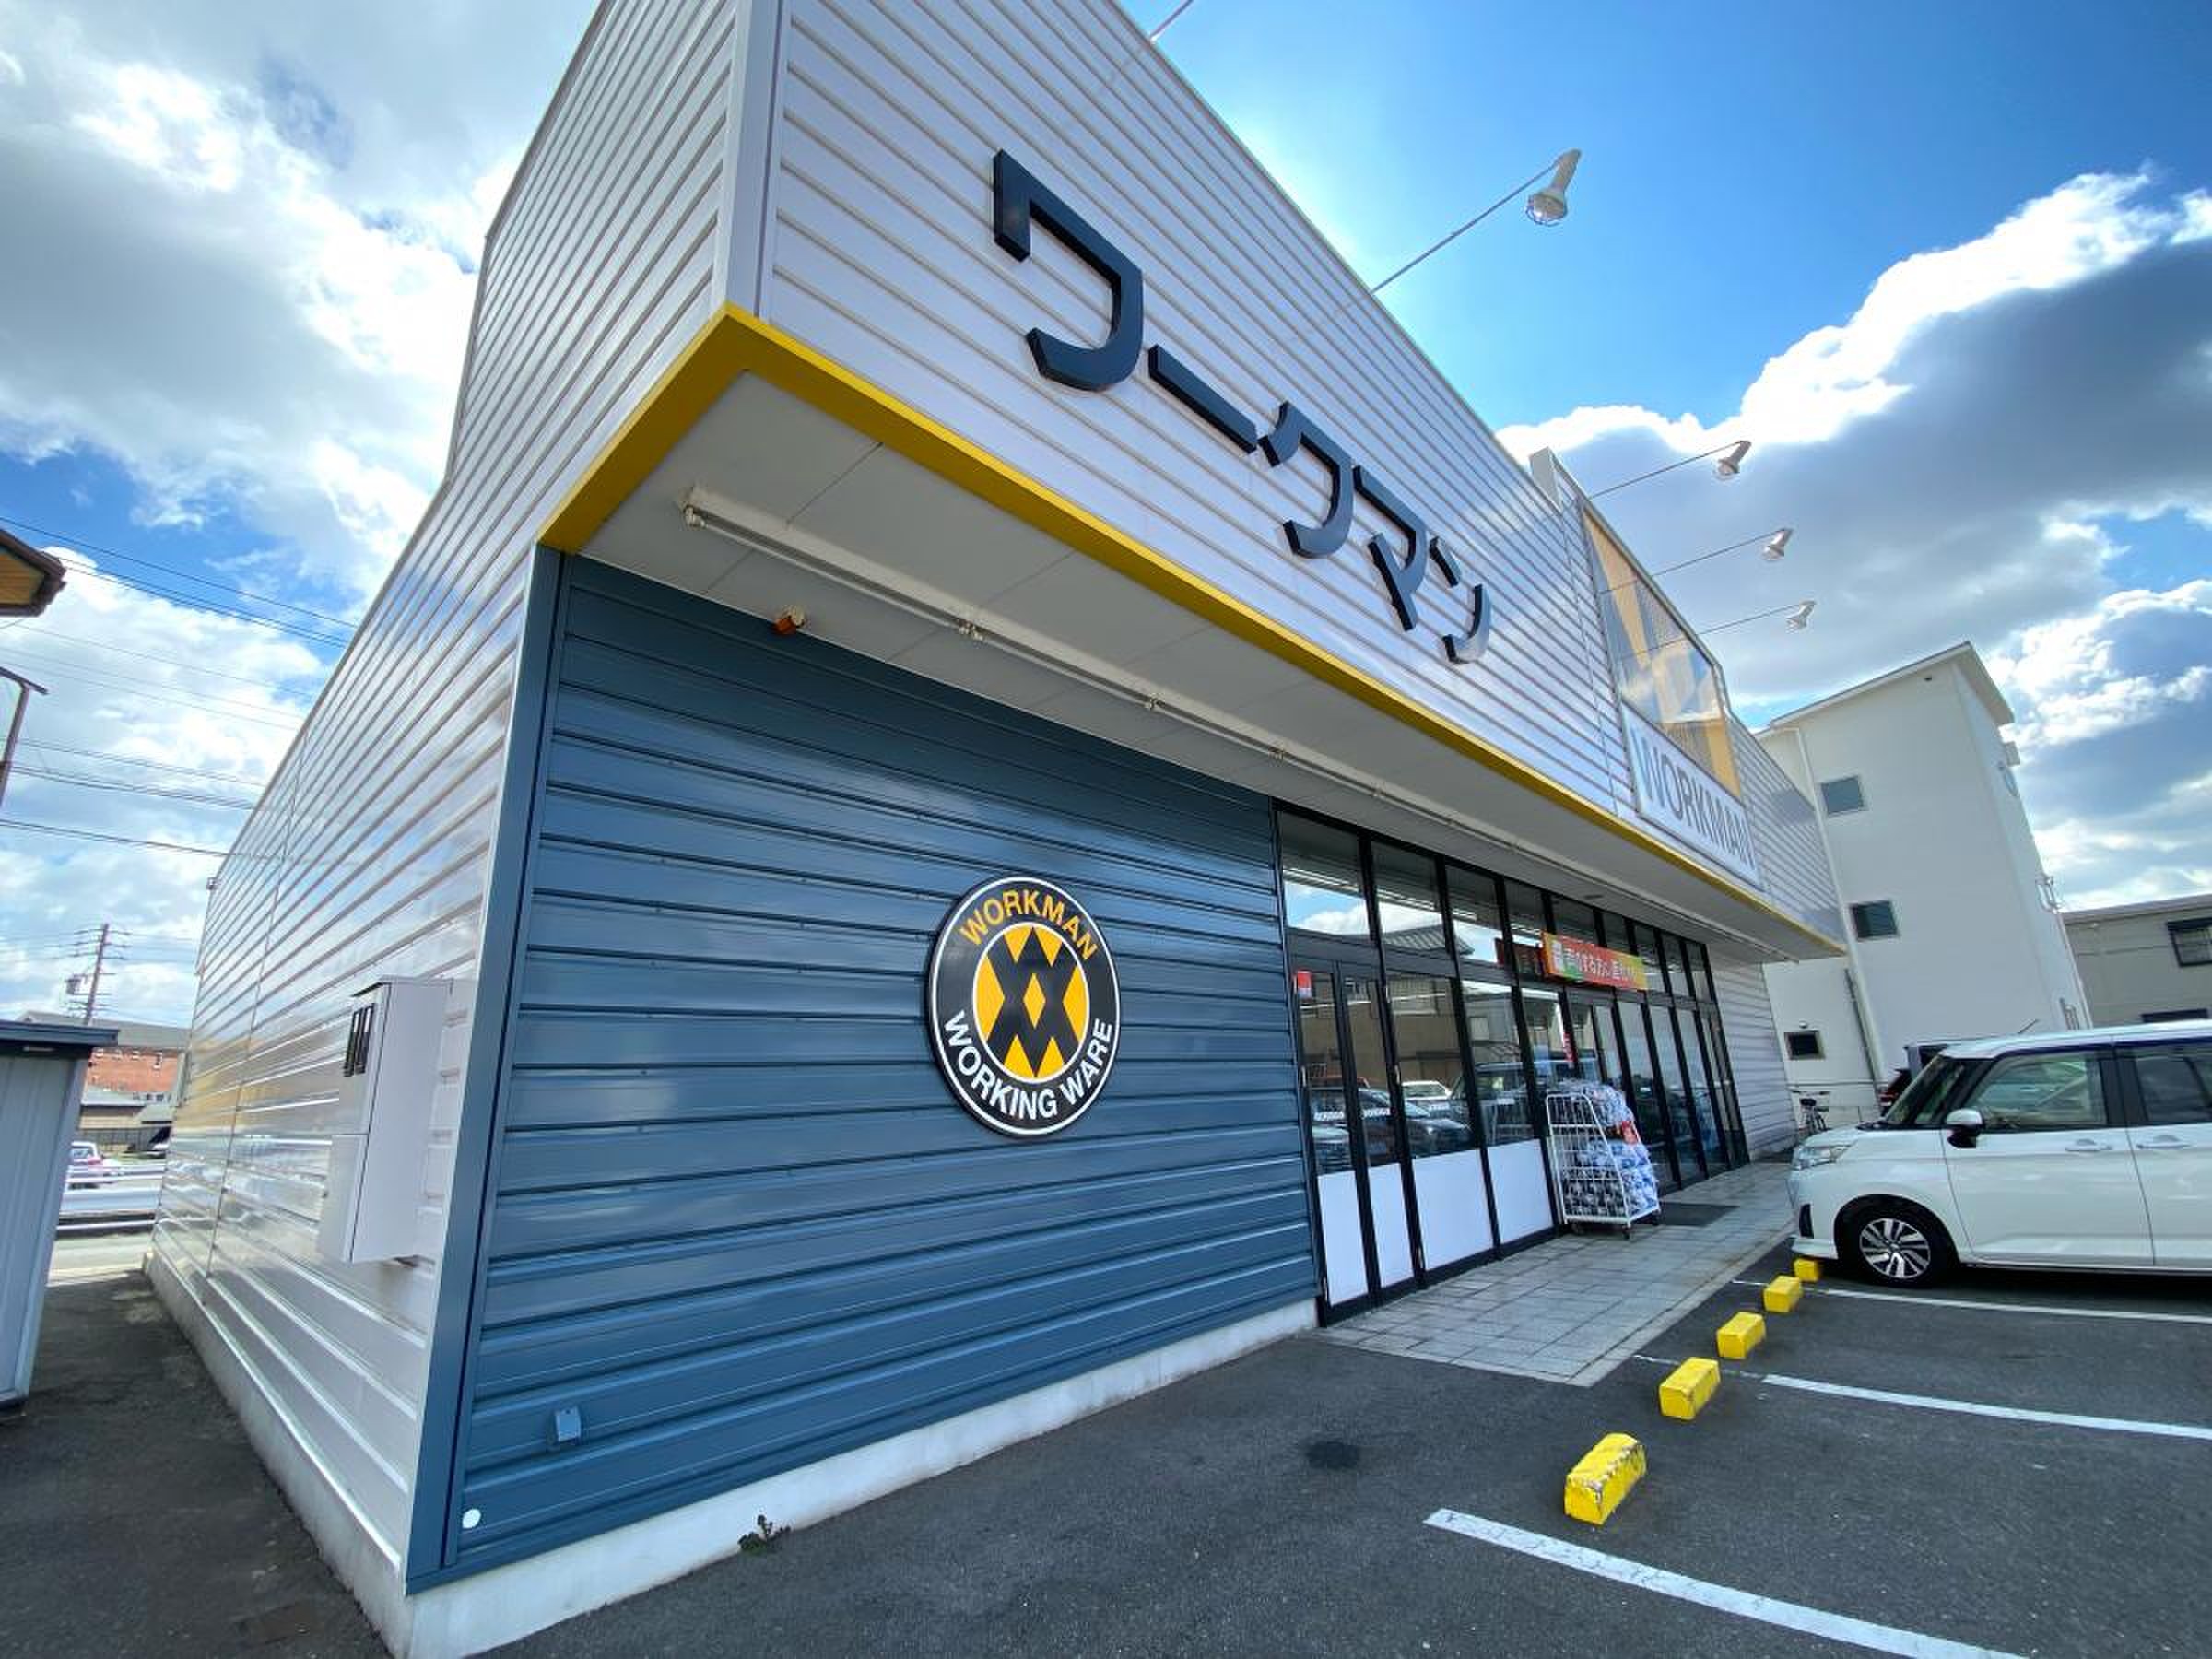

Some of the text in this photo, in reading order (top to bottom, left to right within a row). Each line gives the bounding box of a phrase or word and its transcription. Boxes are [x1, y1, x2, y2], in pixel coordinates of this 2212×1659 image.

[994, 149, 1490, 663] ワークマン
[1630, 725, 1757, 871] WORKMAN
[959, 888, 1098, 960] WORKMAN
[944, 1010, 1112, 1120] WORKING WARE
